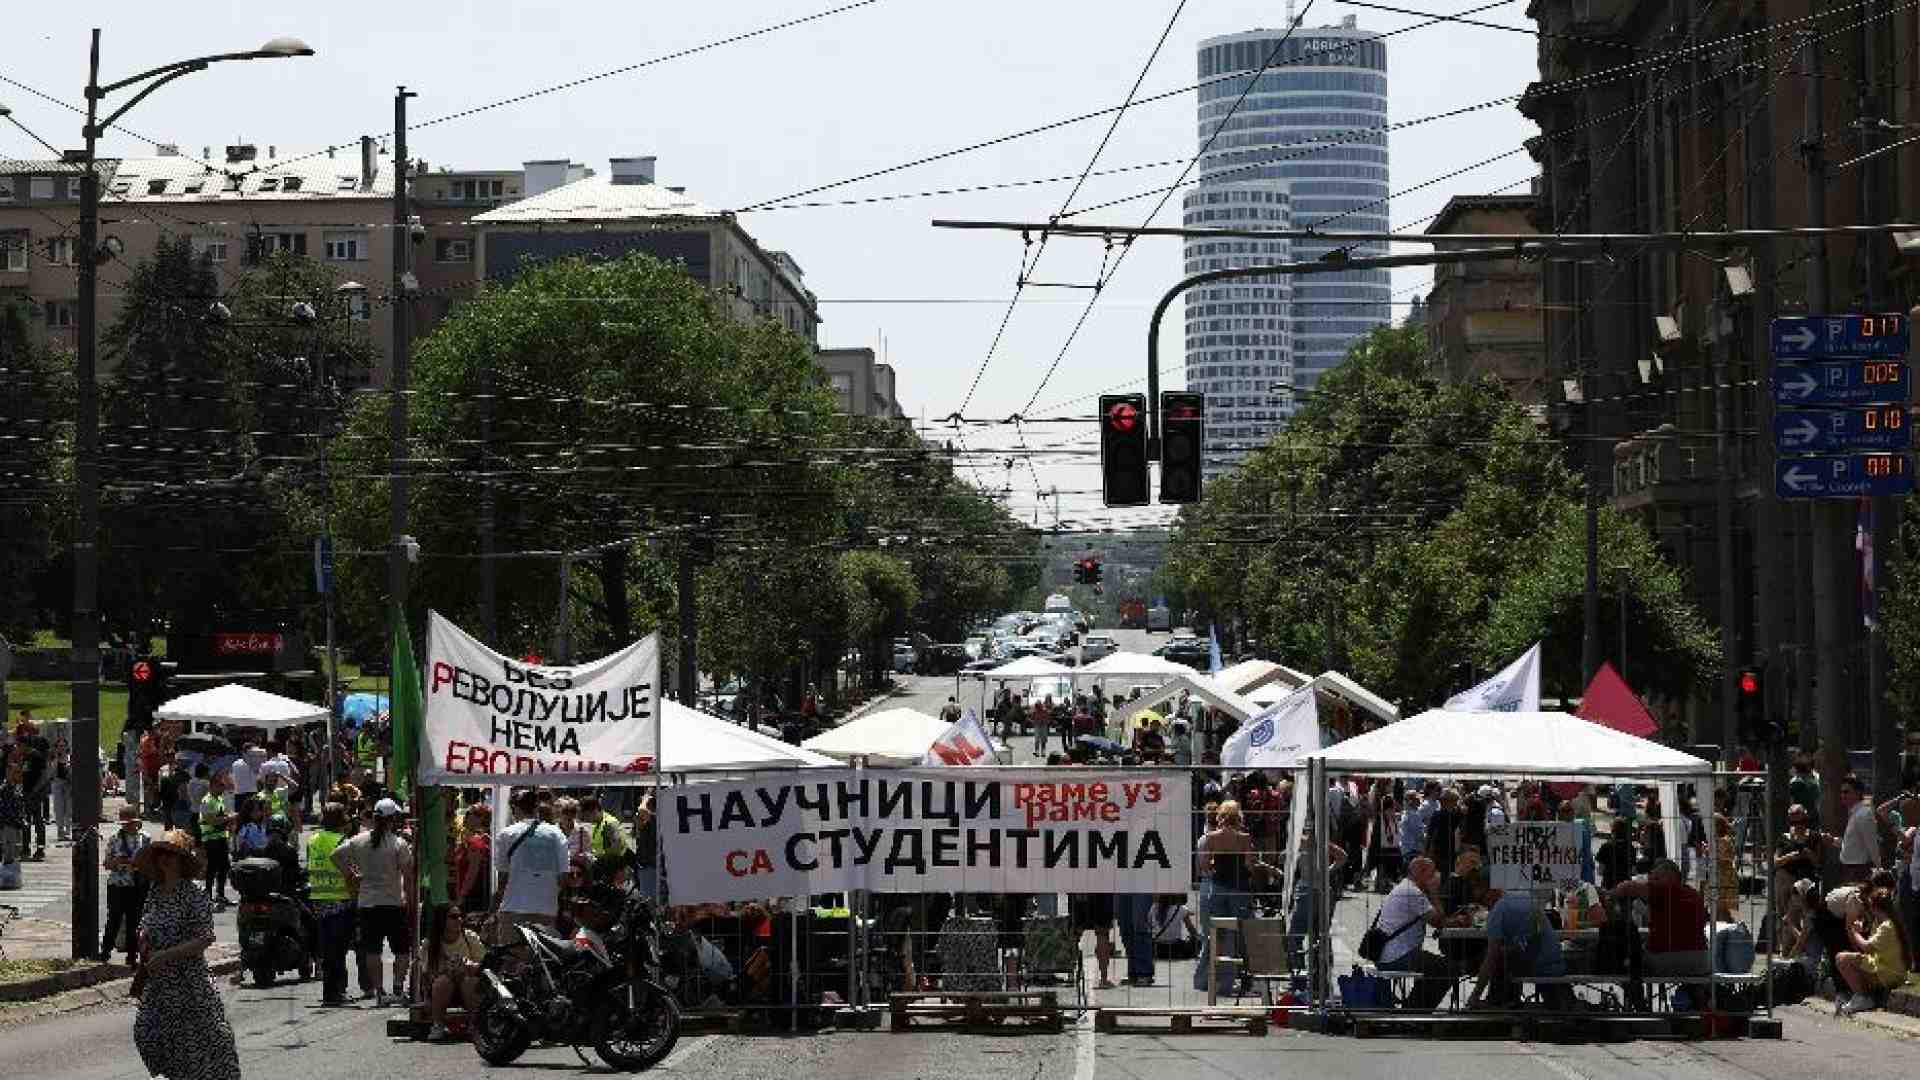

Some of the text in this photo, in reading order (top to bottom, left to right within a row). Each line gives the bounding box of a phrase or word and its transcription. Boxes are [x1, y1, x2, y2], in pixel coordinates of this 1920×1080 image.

[1831, 363, 1899, 386] P 005
[1832, 410, 1901, 434] P 010
[1832, 460, 1847, 479] P
[431, 661, 651, 725] РЕВОЛУЦИЈЕ
[490, 715, 581, 755] НЕМА
[676, 779, 1162, 834] НАУЧНИЦИ раме уз
[1025, 800, 1121, 829] раме
[725, 827, 1172, 878] СА СТУДЕНТИМА
